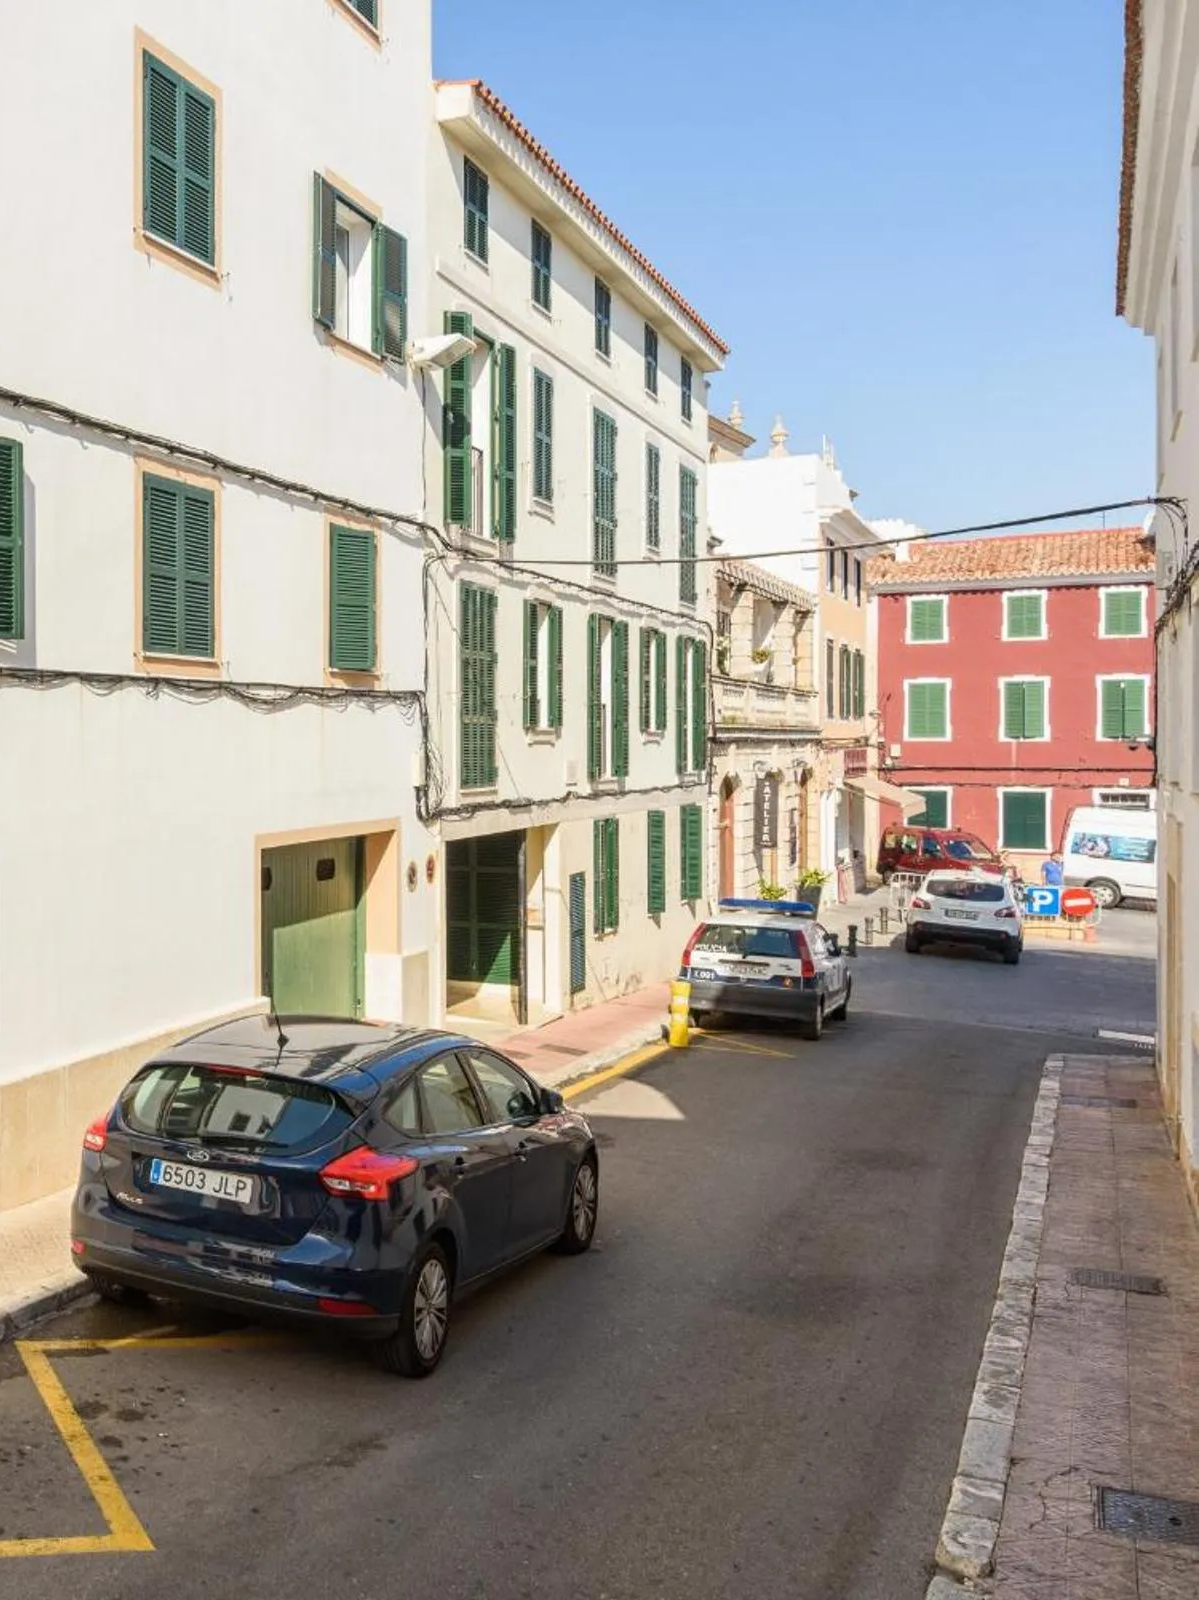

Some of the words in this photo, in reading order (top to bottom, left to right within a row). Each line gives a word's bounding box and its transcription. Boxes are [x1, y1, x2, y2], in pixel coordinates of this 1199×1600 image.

[762, 786, 771, 841] ATELIER
[1032, 890, 1054, 912] P
[162, 1164, 207, 1190] 6503
[212, 1175, 248, 1198] JLP
